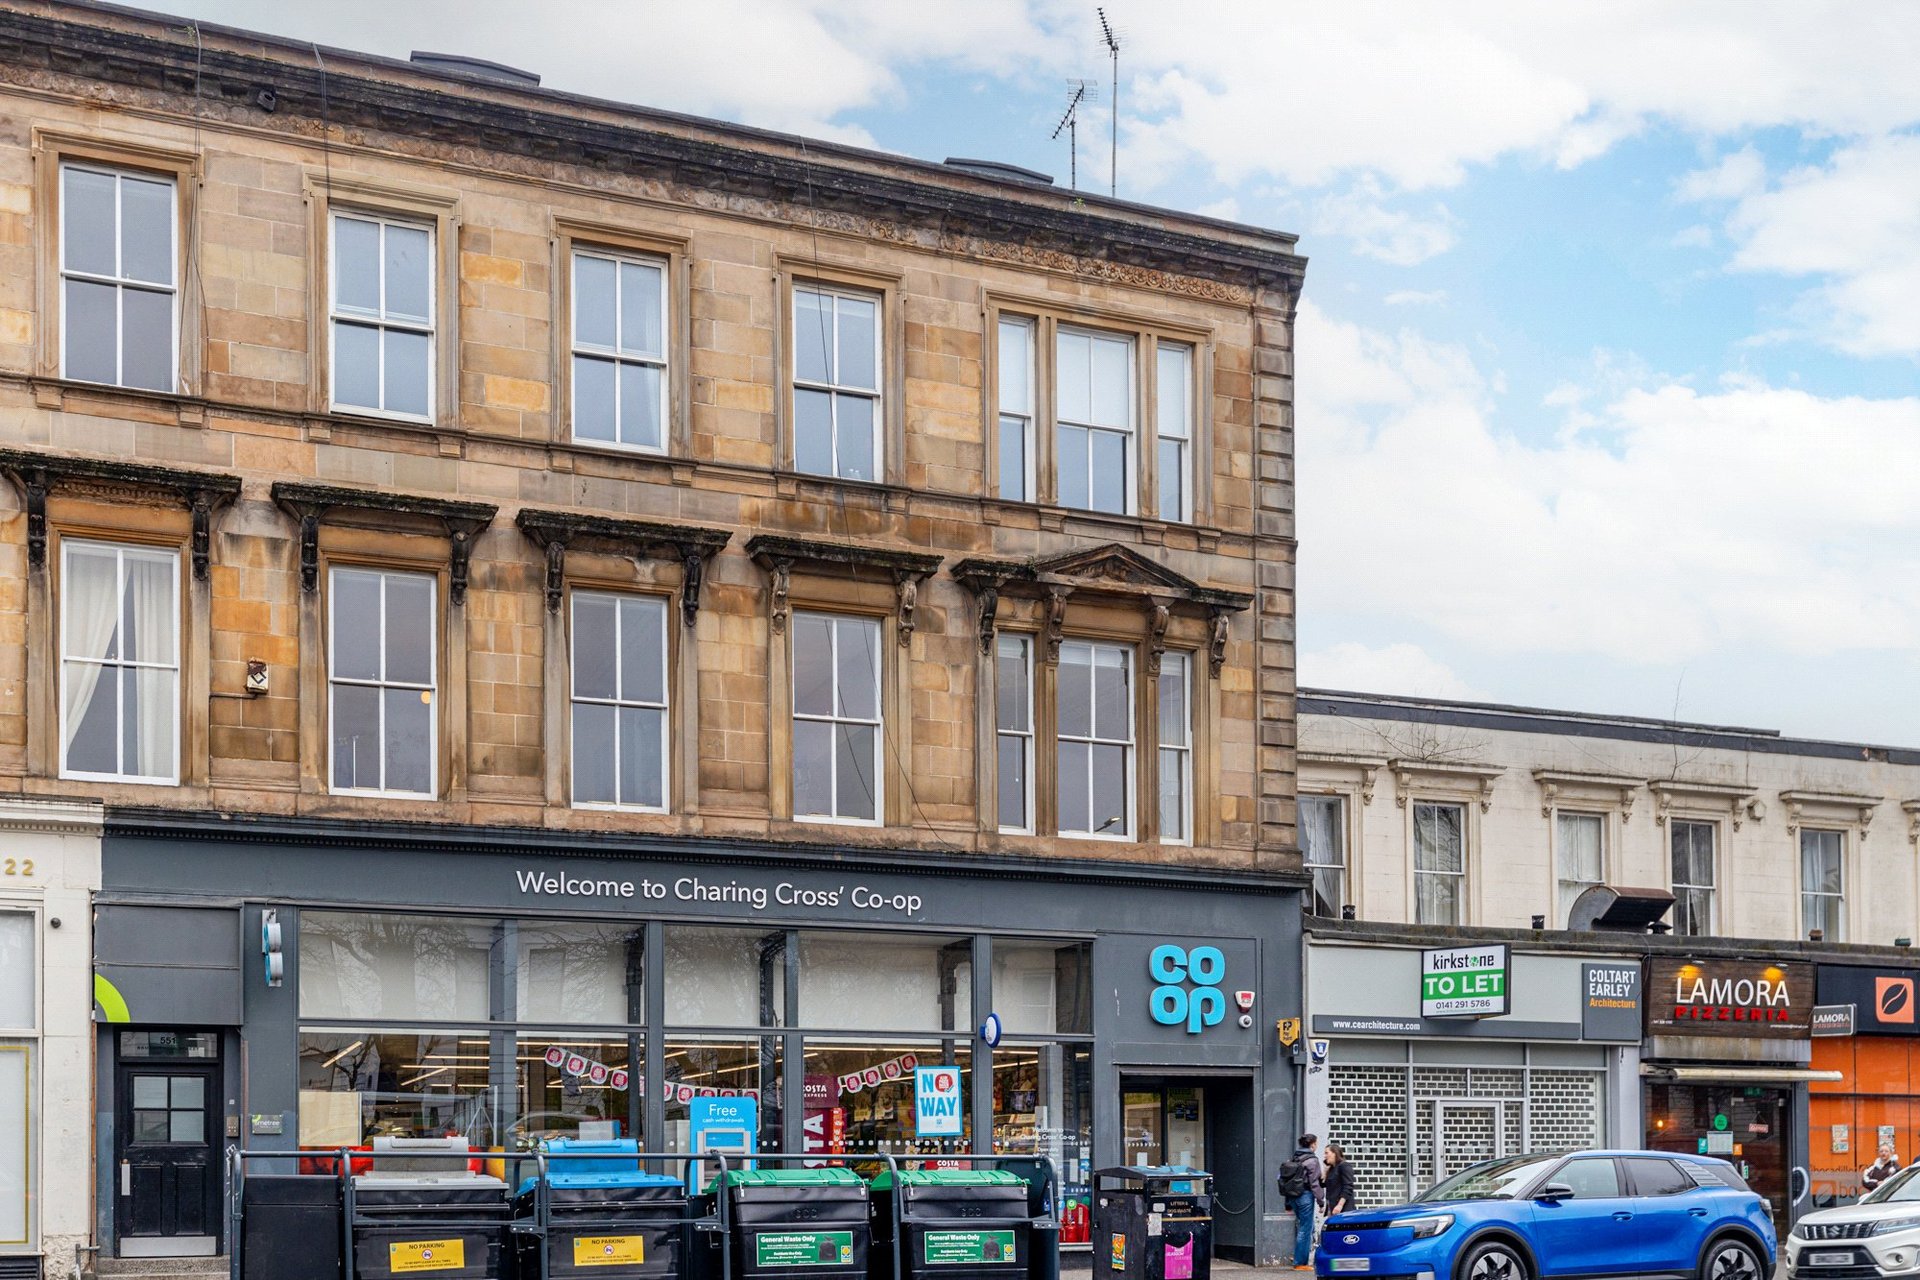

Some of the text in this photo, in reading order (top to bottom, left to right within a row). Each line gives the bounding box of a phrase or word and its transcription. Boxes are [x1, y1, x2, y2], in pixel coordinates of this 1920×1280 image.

[516, 870, 635, 898] Welcome
[641, 879, 667, 899] to
[674, 877, 767, 909] Charing
[851, 886, 922, 916] Co-op
[1589, 969, 1636, 984] COLTART
[1425, 973, 1503, 996] TO LET
[1589, 983, 1631, 997] EARLEY
[1675, 977, 1791, 1007] LAMORA
[1435, 1002, 1453, 1010] 0141
[1470, 1000, 1491, 1008] 5786
[1589, 997, 1637, 1009] Architecture
[1674, 1005, 1790, 1021] PIZZERIA
[1813, 1013, 1850, 1024] LAMORA
[1332, 1020, 1421, 1031] www.cearchitecture.com
[160, 1036, 177, 1045] 551
[709, 1103, 738, 1116] Free
[920, 1097, 957, 1117] WAY
[802, 1235, 816, 1243] Only
